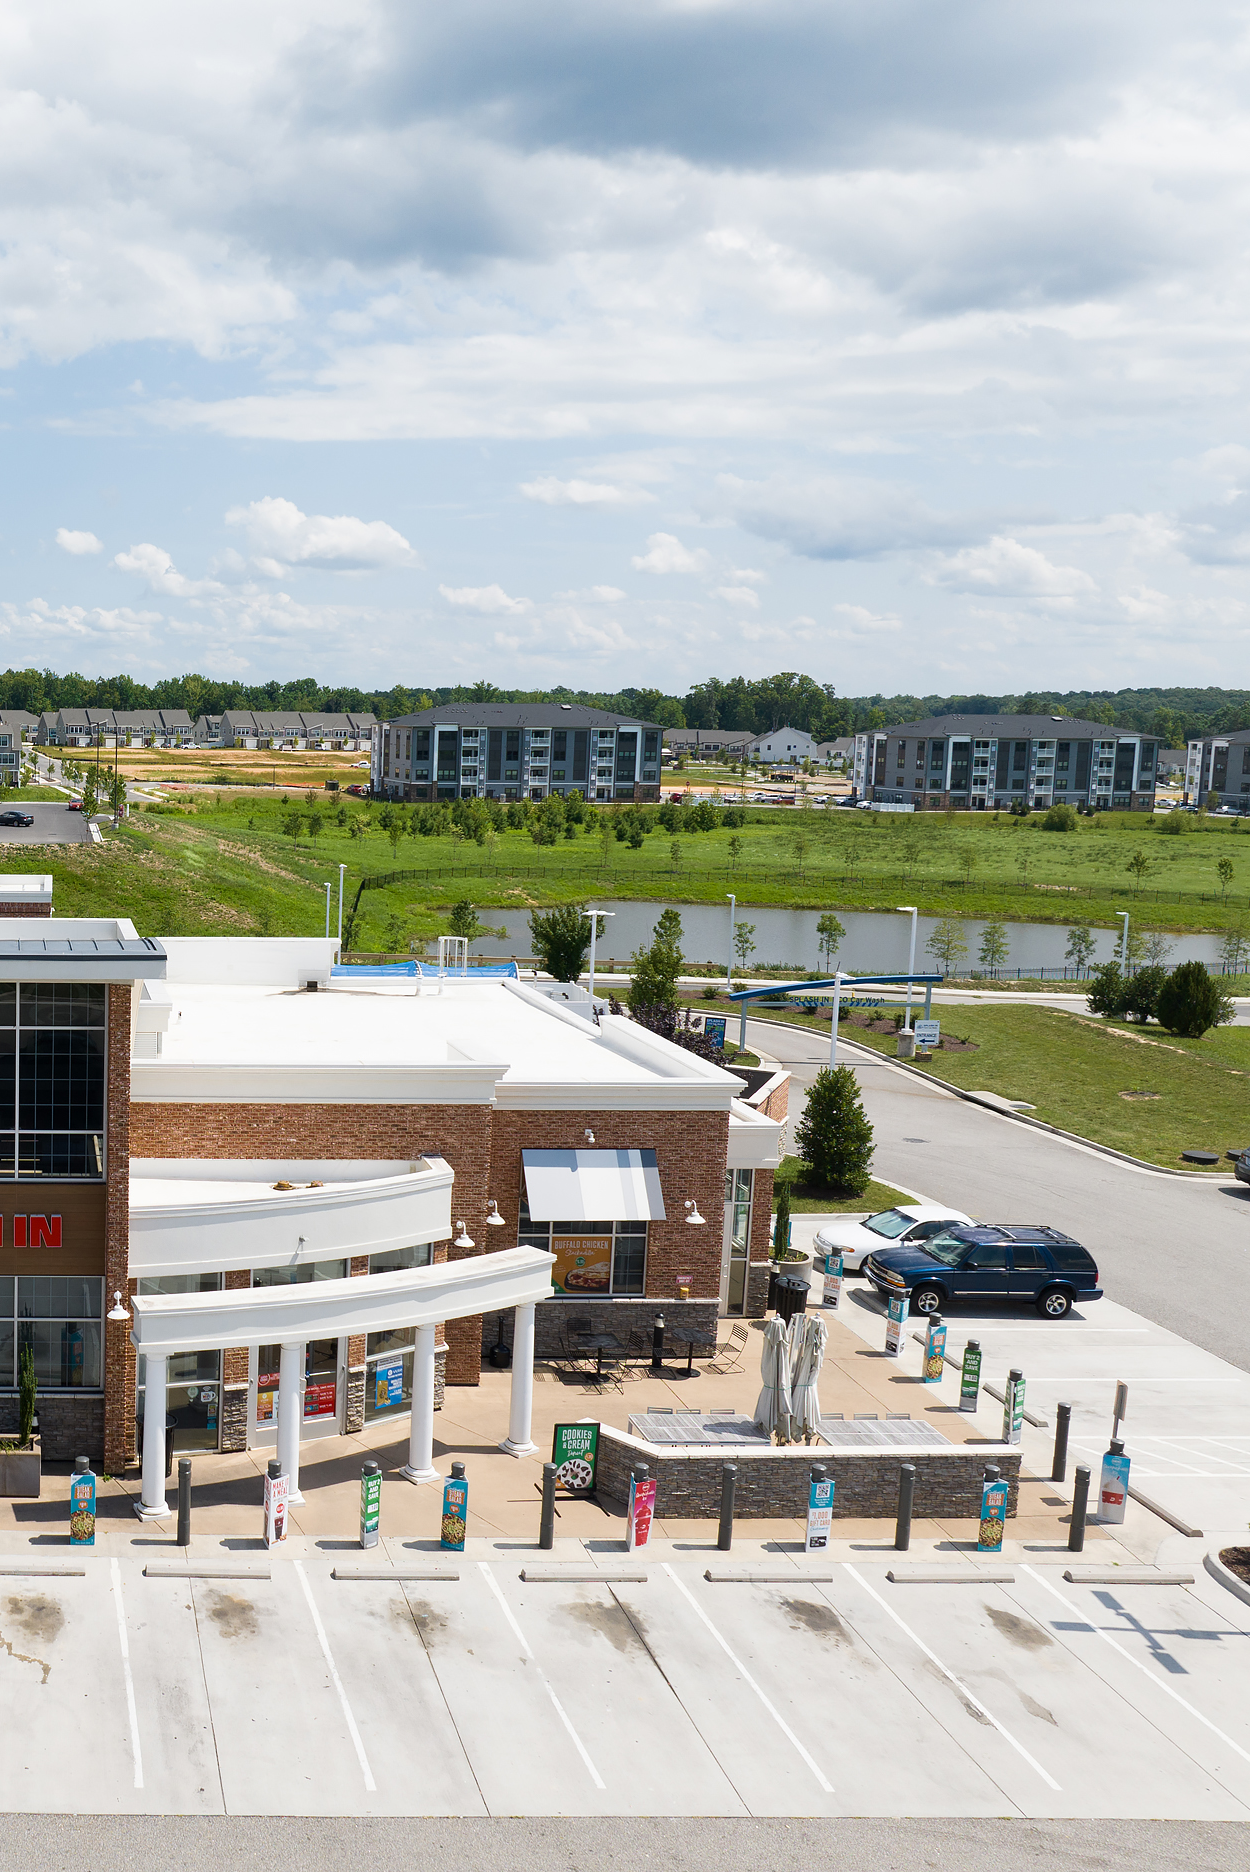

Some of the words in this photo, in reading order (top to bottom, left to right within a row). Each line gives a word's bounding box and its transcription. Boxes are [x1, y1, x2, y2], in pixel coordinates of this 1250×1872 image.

[14, 1214, 62, 1248] IN
[555, 1240, 580, 1249] BUFFALO
[582, 1241, 608, 1249] CHICKEN
[562, 1429, 592, 1441] COOKIES
[568, 1439, 590, 1450] CREAM
[272, 1480, 283, 1489] MAKE
[277, 1488, 287, 1496] MEAL
[368, 1492, 379, 1500] SAVE
